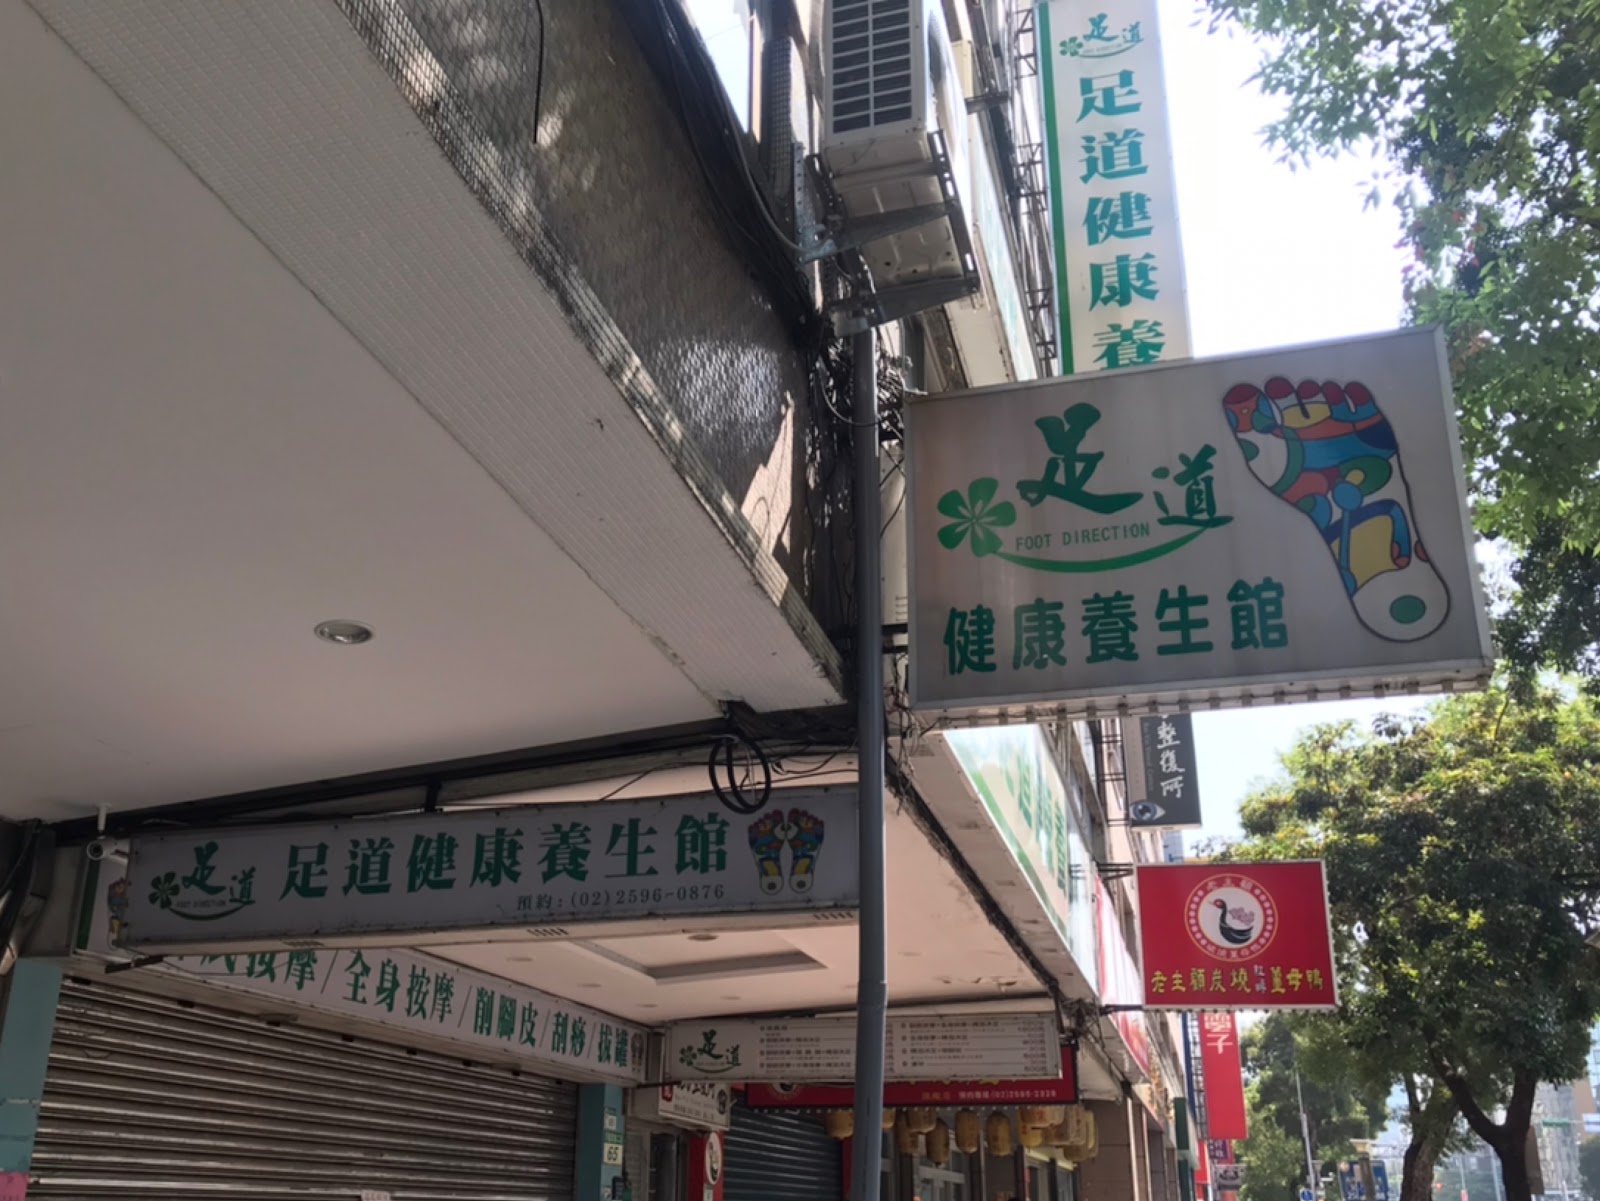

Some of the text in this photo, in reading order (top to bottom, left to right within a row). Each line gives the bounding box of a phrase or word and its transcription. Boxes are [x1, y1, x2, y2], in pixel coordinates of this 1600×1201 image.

[1083, 13, 1145, 43] 足道
[1016, 402, 1234, 529] 足道
[1015, 521, 1151, 552] FOOT DIRECTION
[943, 576, 1289, 676] 健康養生館
[1156, 714, 1186, 798] 整復所
[182, 841, 257, 905] 足道
[280, 812, 731, 901] 足道健康養生館
